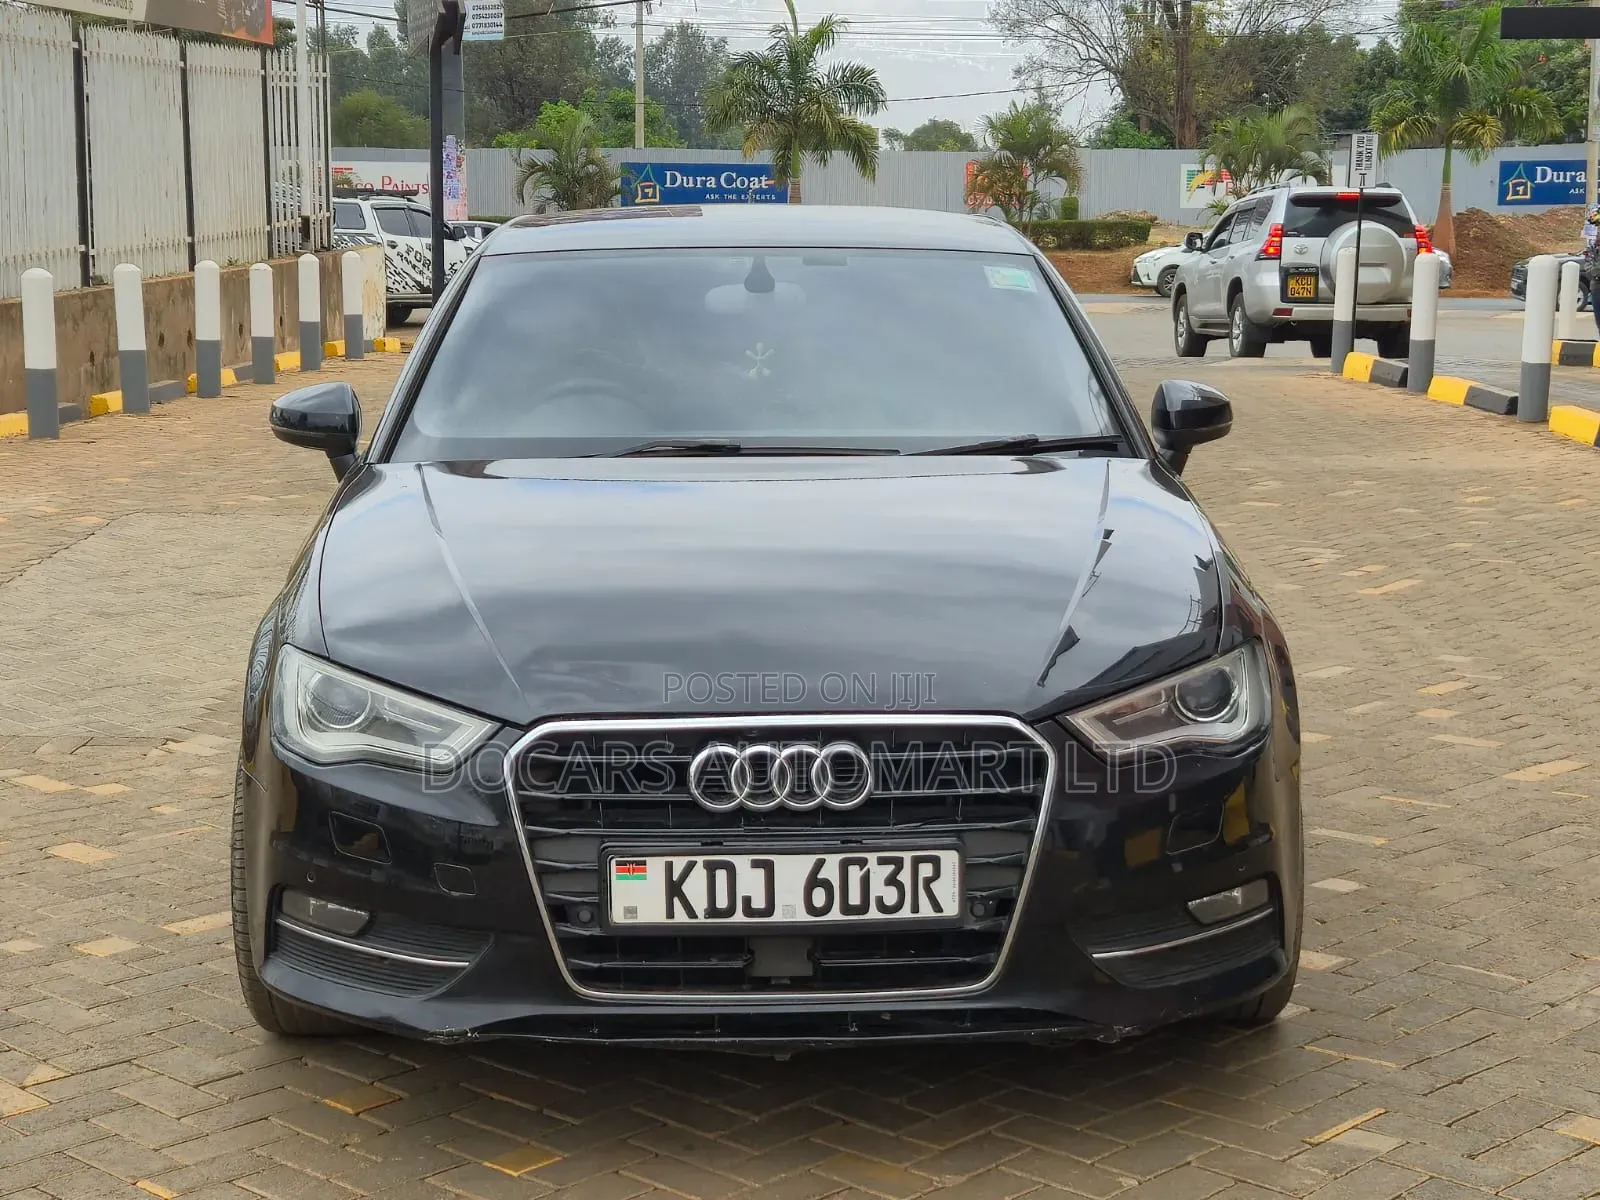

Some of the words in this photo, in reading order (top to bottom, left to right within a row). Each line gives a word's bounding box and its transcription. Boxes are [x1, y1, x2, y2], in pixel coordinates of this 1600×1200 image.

[1356, 135, 1365, 149] YOU
[1355, 150, 1364, 171] THANK
[1364, 148, 1373, 162] NEXT
[664, 170, 717, 189] Dura
[720, 171, 769, 189] Coat
[1534, 166, 1587, 184] Dura
[1290, 286, 1312, 297] 047N
[664, 858, 776, 920] KDJ
[803, 854, 944, 918] 603R
